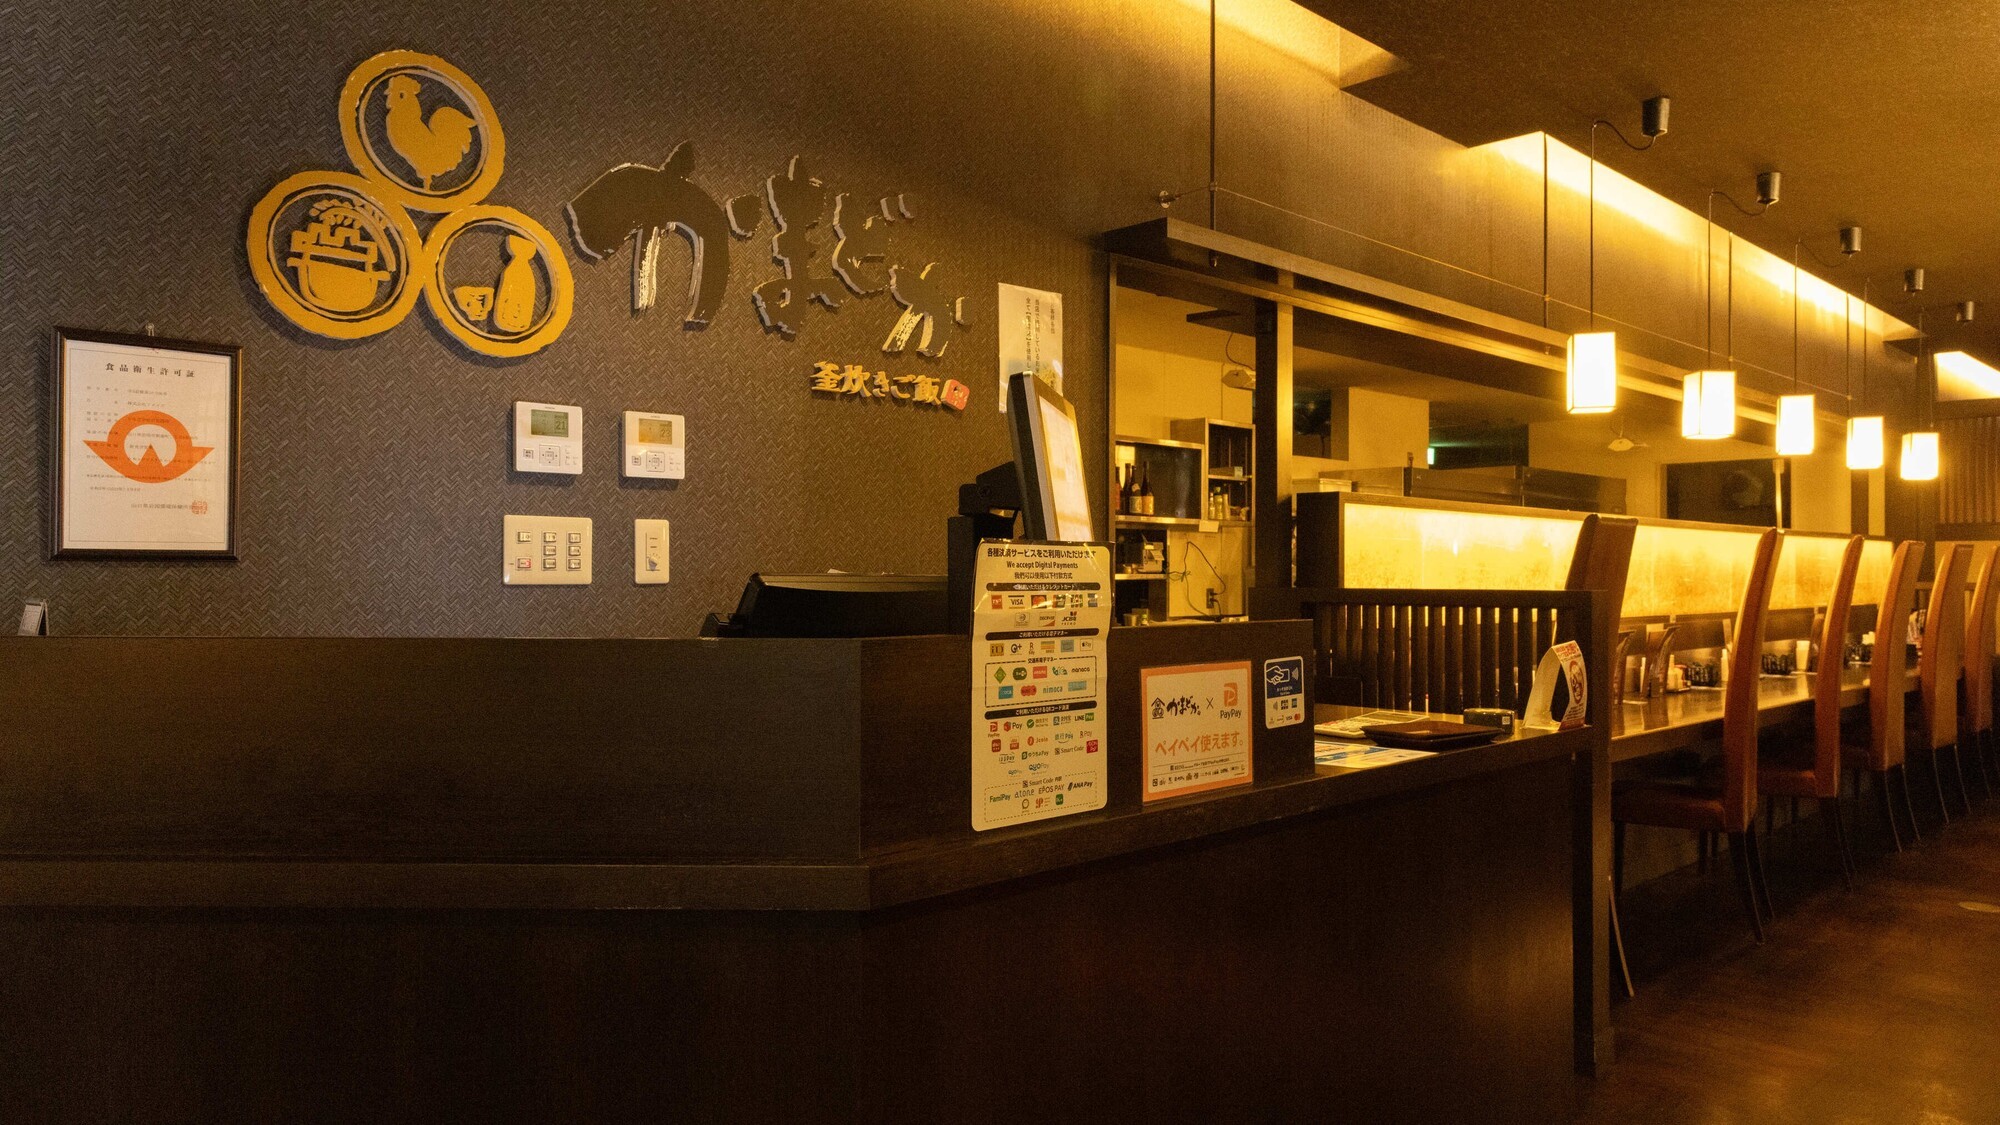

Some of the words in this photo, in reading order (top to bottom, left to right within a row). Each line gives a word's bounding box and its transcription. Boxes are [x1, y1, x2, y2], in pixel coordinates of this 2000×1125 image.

[105, 362, 195, 378] 食品衛生許可証
[811, 361, 941, 406] 釜炊きご飯
[1016, 561, 1034, 570] accept
[1035, 561, 1052, 570] Digital
[1053, 561, 1078, 570] Payments
[1011, 598, 1024, 606] VISA
[1043, 685, 1063, 694] nimoca
[1220, 709, 1241, 719] PayPay
[1155, 730, 1243, 756] ペイペイ使えます。
[1029, 779, 1042, 787] Smart
[989, 793, 1011, 803] FamiPay
[1038, 787, 1054, 795] EPOS
[1054, 784, 1064, 792] PAY
[1073, 782, 1084, 790] ANA
